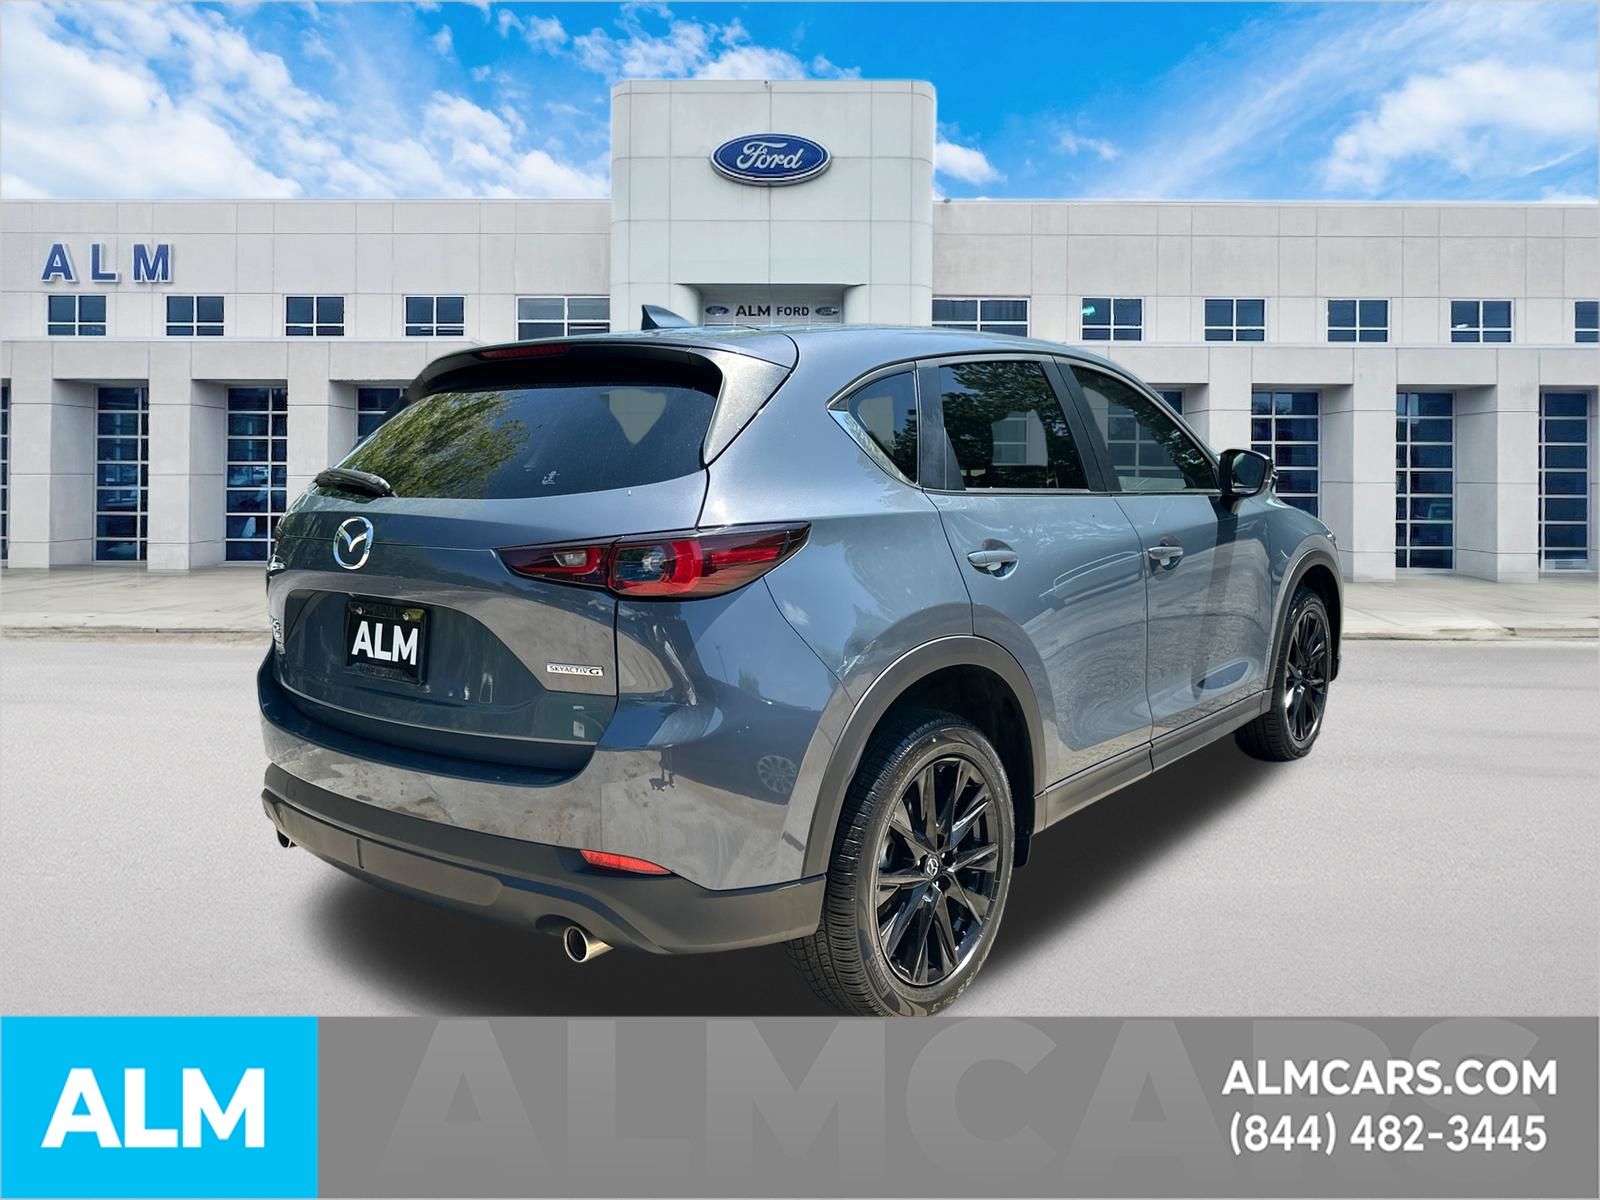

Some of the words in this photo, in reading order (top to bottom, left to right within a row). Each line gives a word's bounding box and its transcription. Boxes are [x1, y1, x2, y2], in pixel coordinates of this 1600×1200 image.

[736, 141, 804, 169] Ford
[41, 242, 173, 283] ALM
[735, 305, 771, 317] ALM
[776, 306, 810, 317] FORD
[351, 620, 419, 666] ALM
